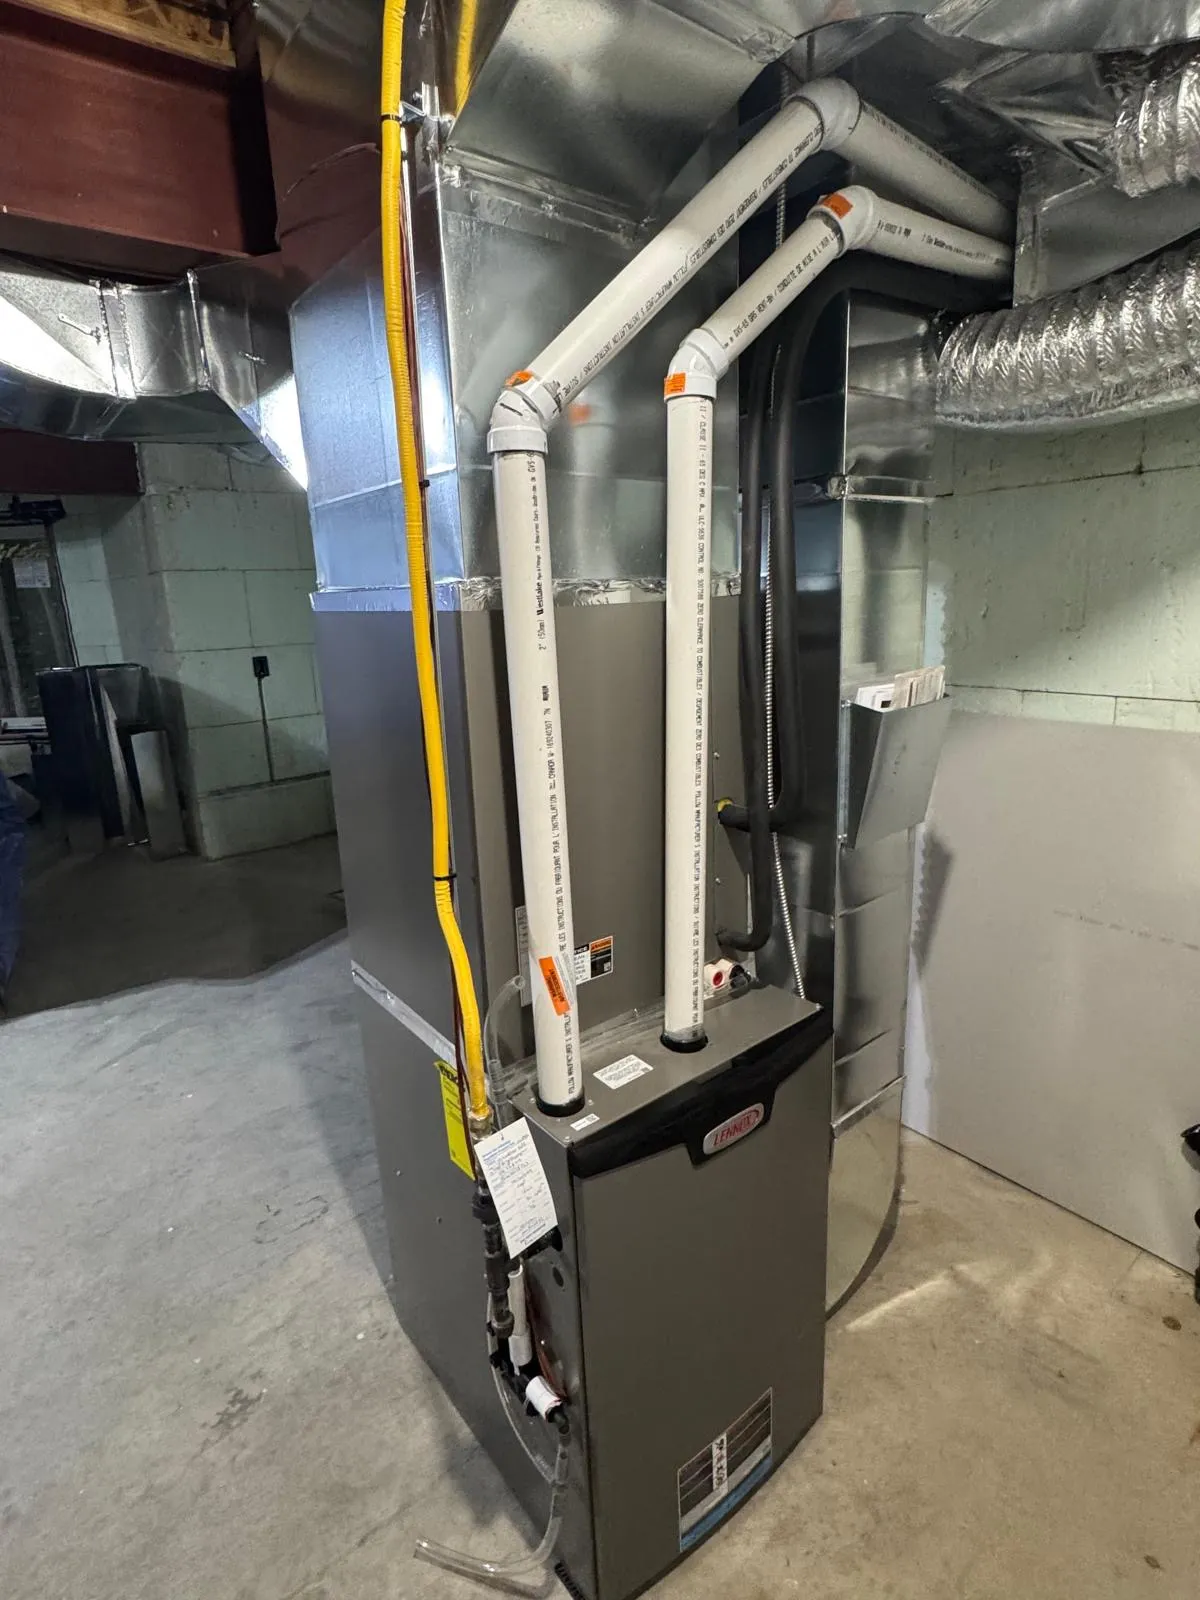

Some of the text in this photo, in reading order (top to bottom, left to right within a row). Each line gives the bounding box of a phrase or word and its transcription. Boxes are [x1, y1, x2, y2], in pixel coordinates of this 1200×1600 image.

[536, 582, 544, 615] Westlake
[552, 840, 560, 853] POUR
[555, 886, 563, 894] DU
[556, 896, 565, 930] INSTRUCTIONS
[713, 1114, 752, 1146] LENNOX
